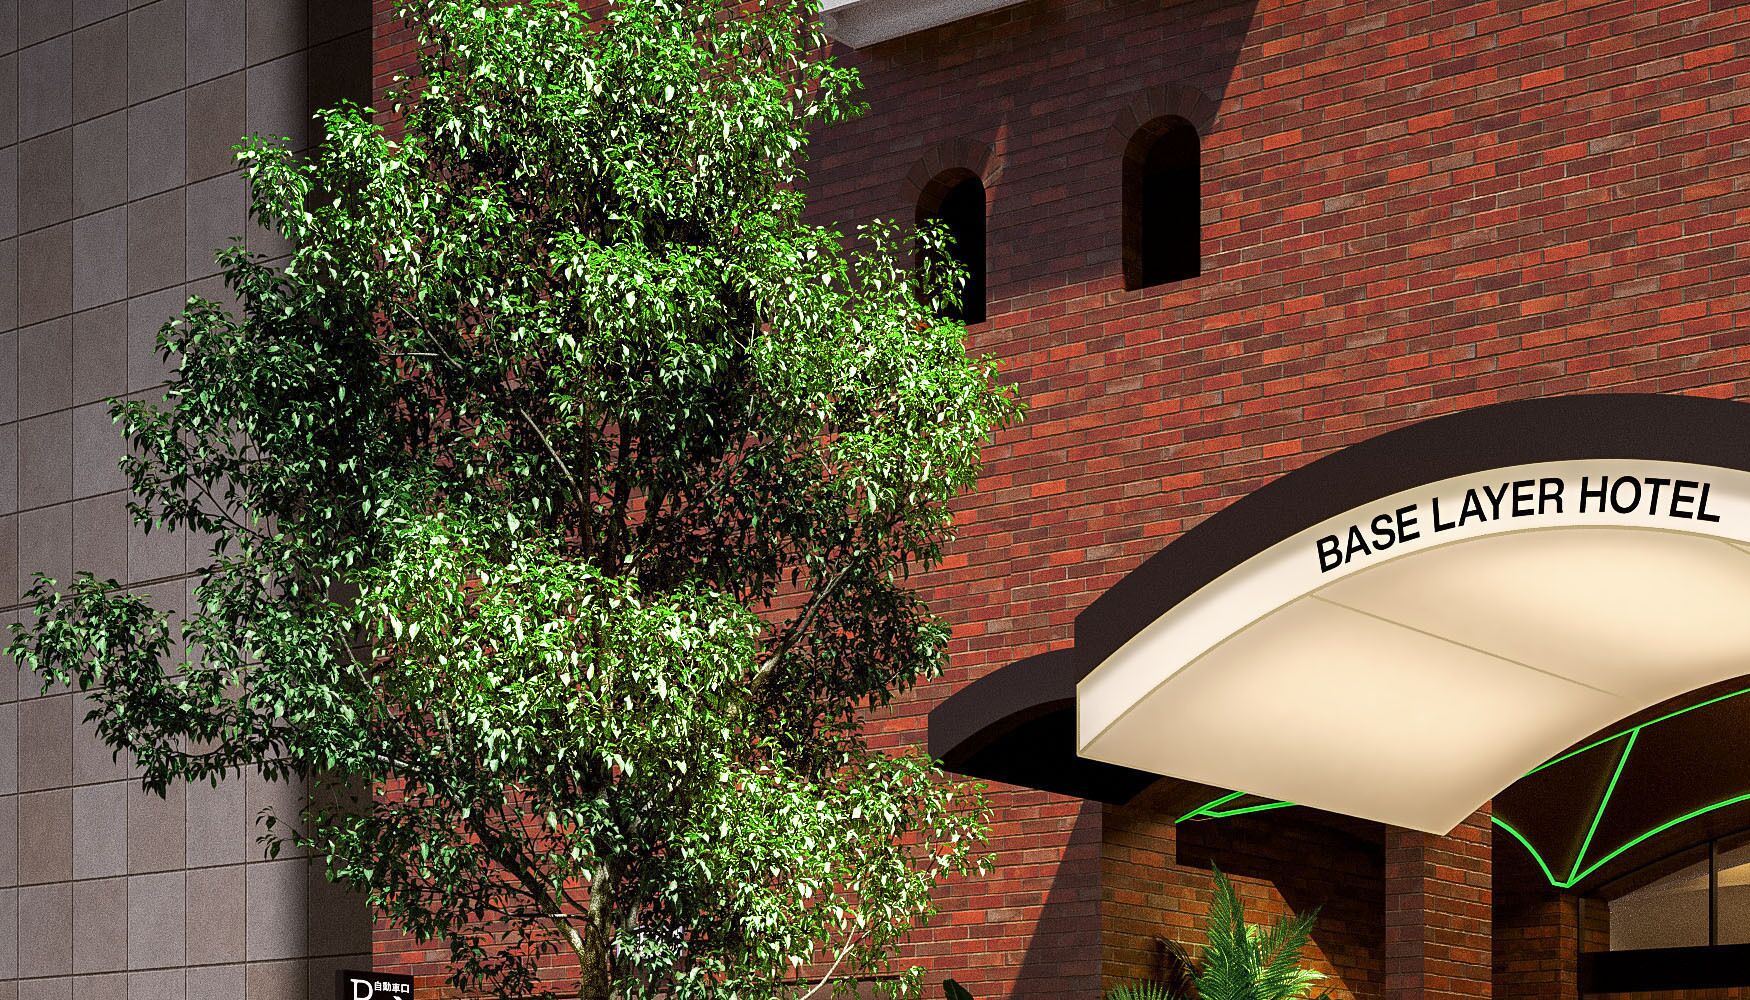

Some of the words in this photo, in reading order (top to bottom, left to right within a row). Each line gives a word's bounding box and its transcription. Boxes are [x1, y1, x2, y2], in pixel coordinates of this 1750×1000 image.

[1316, 503, 1420, 573] BASE
[1432, 477, 1563, 533] LAYER
[1578, 475, 1721, 523] HOTEL
[374, 981, 410, 994] 自動車口
